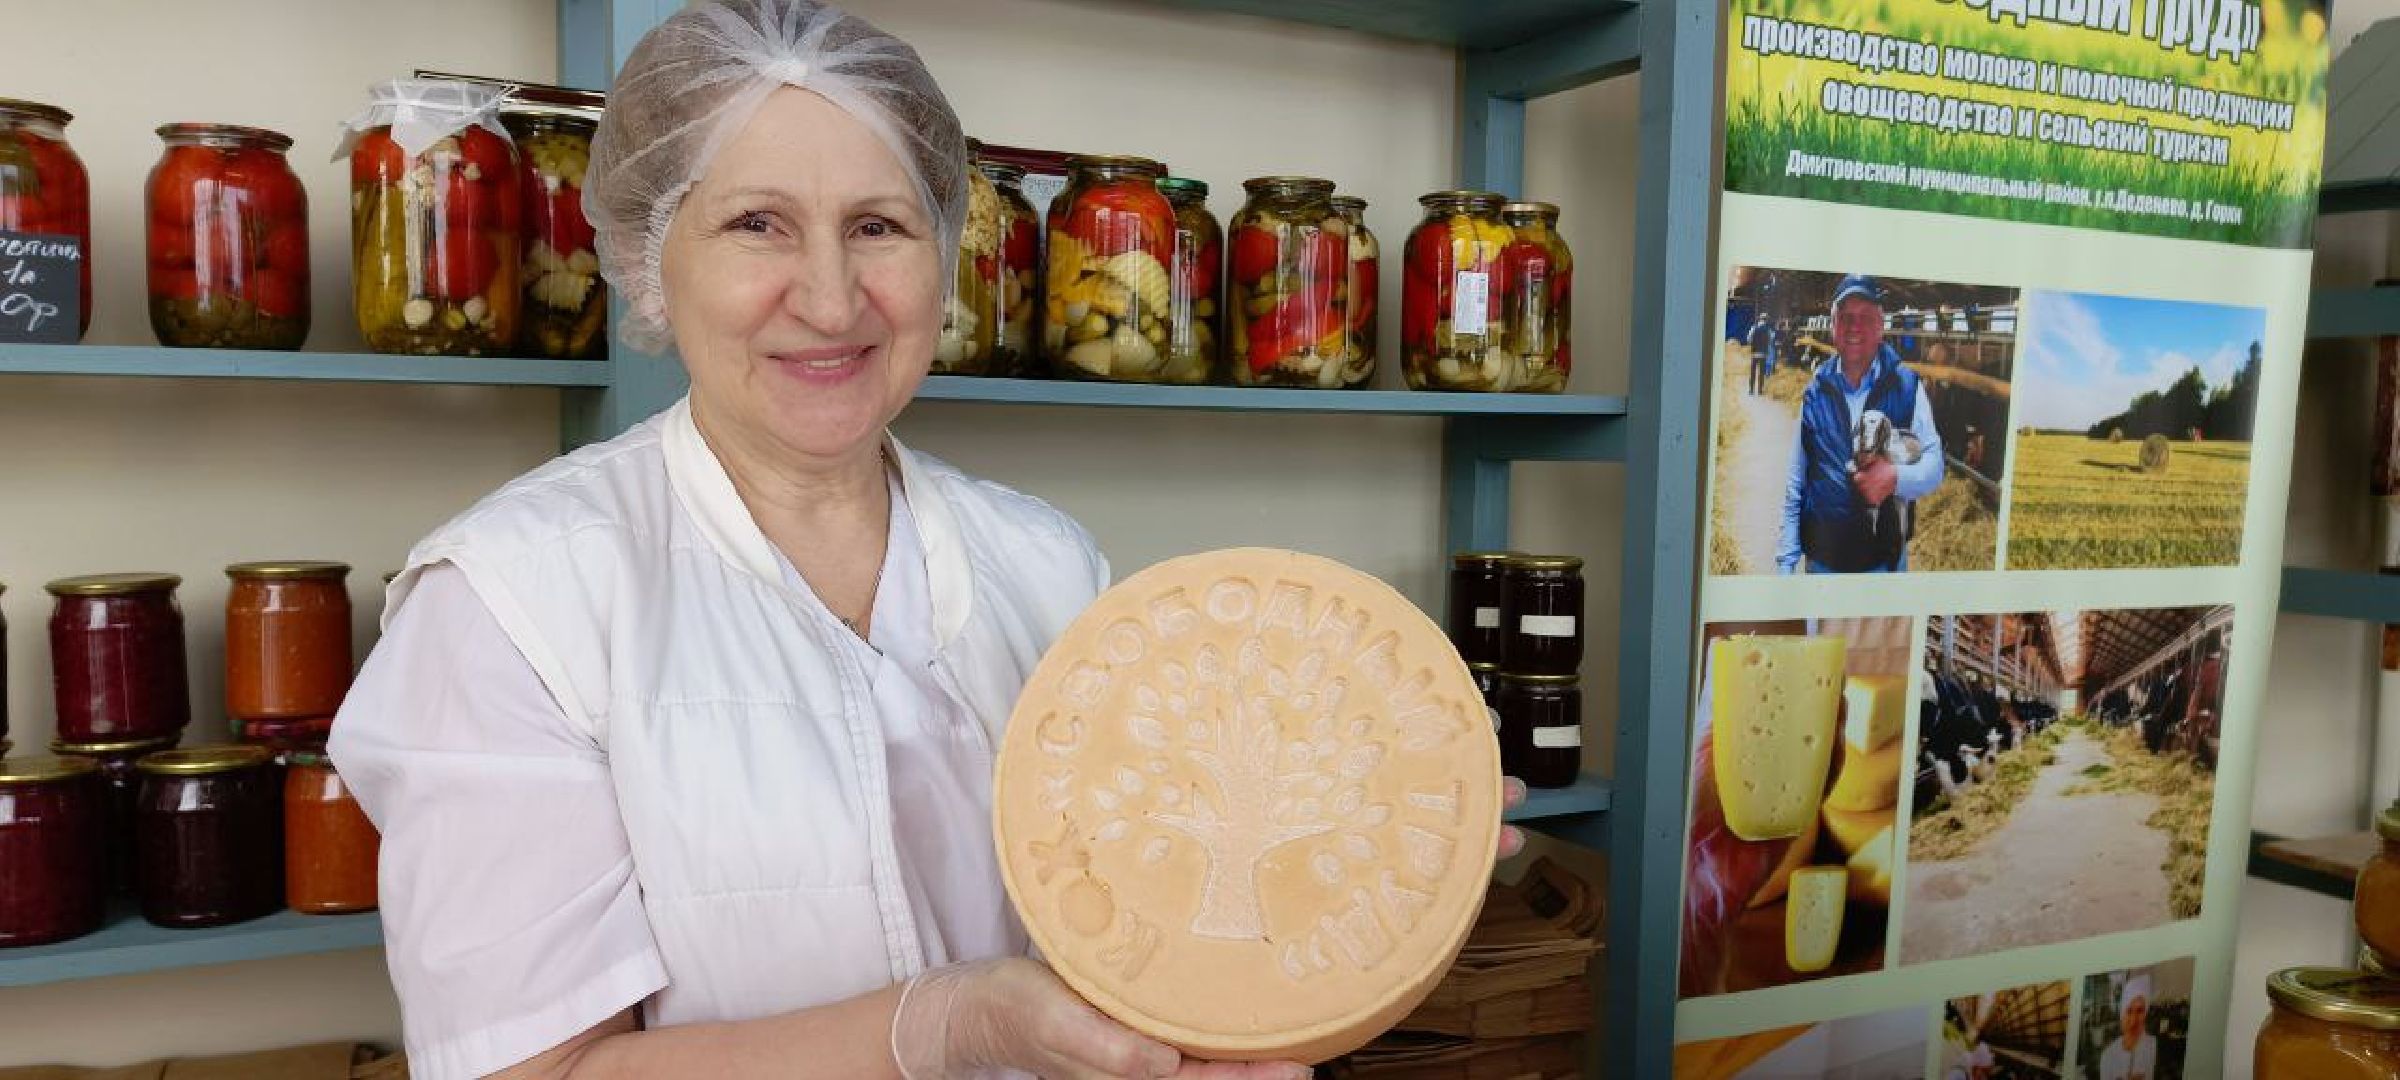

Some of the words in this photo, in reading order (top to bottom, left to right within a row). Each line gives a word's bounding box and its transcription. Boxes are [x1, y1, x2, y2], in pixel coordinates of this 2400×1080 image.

[1742, 14, 1938, 76] производство
[1943, 46, 2036, 91] молока
[2040, 62, 2057, 94] и
[2060, 65, 2174, 112] молочной
[2177, 86, 2294, 132] продукции
[1822, 78, 2013, 136] овощеводство
[2016, 106, 2036, 138] и
[2039, 111, 2148, 154] сельский
[2150, 128, 2230, 166] туризм
[1785, 150, 1906, 183] Дмитровский
[1909, 166, 2042, 199] муниципальный
